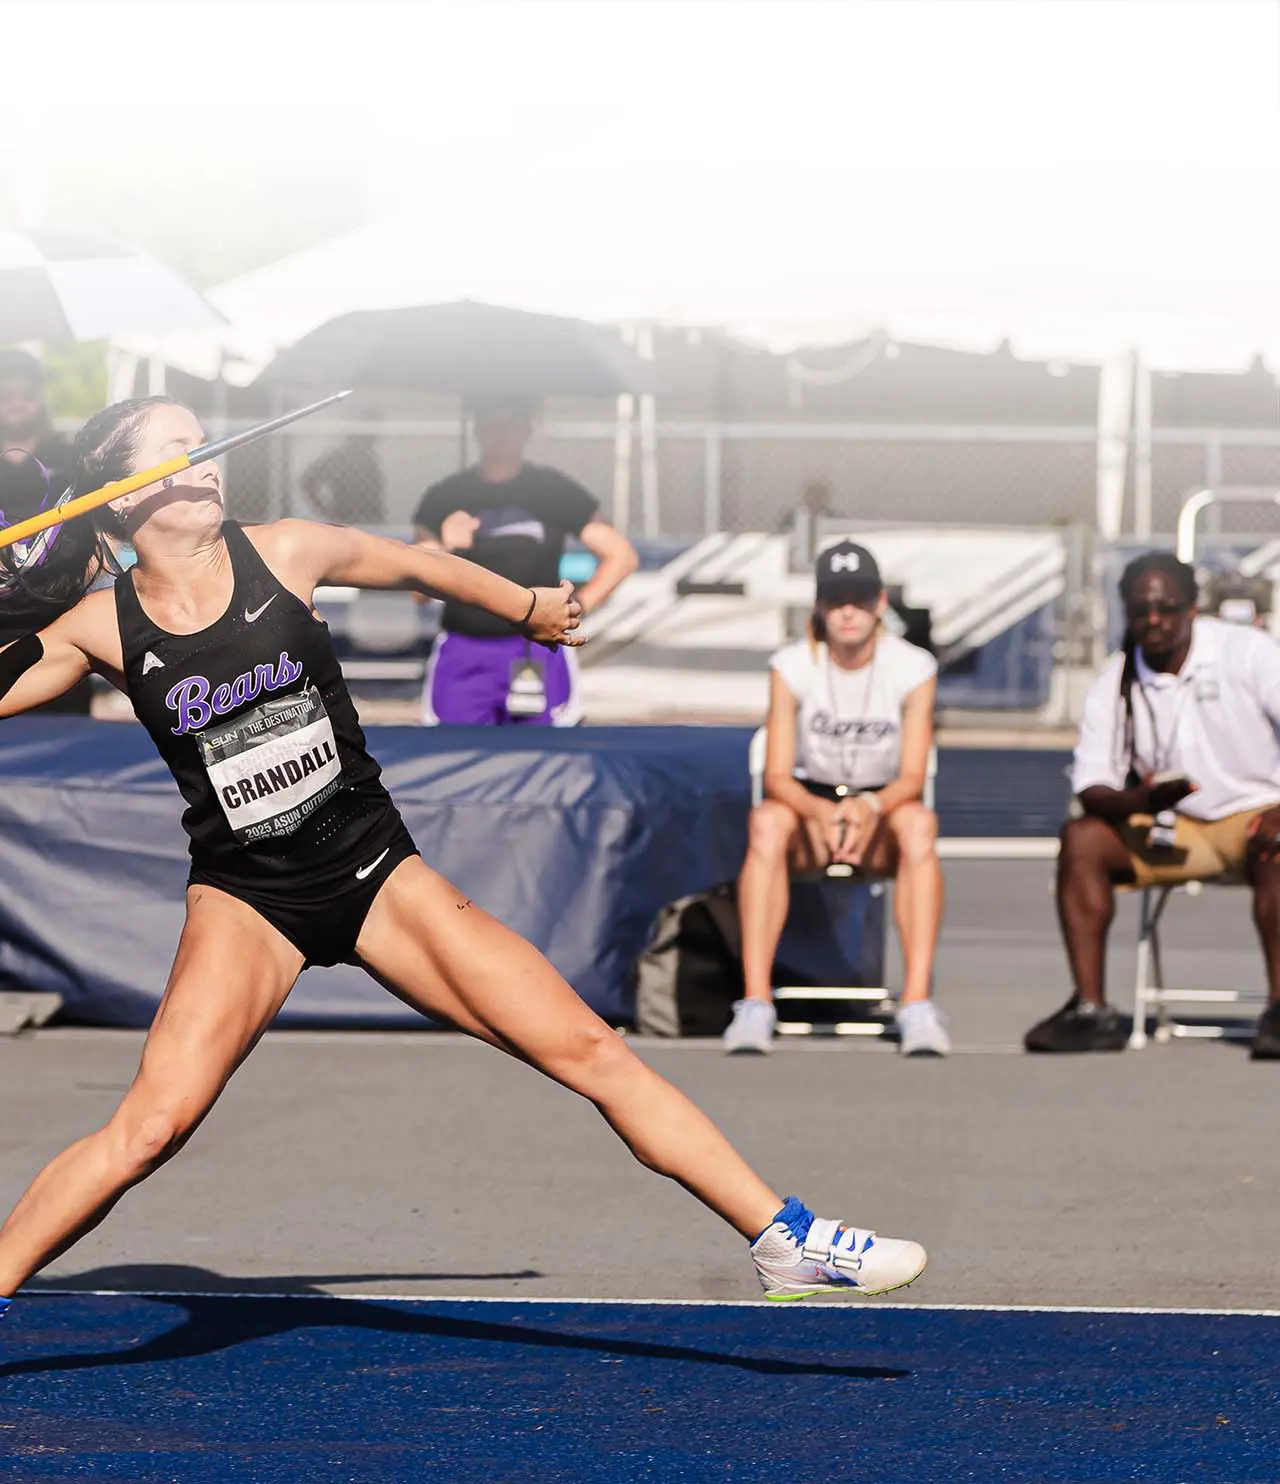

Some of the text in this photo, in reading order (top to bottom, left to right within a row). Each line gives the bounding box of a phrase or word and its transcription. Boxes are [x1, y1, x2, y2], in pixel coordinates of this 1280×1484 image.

[166, 652, 302, 735] Bears
[204, 731, 239, 750] ASUN
[247, 719, 265, 735] THE
[221, 741, 336, 810] CRANDALL
[245, 822, 273, 839] 2025
[273, 808, 302, 830] ASUN
